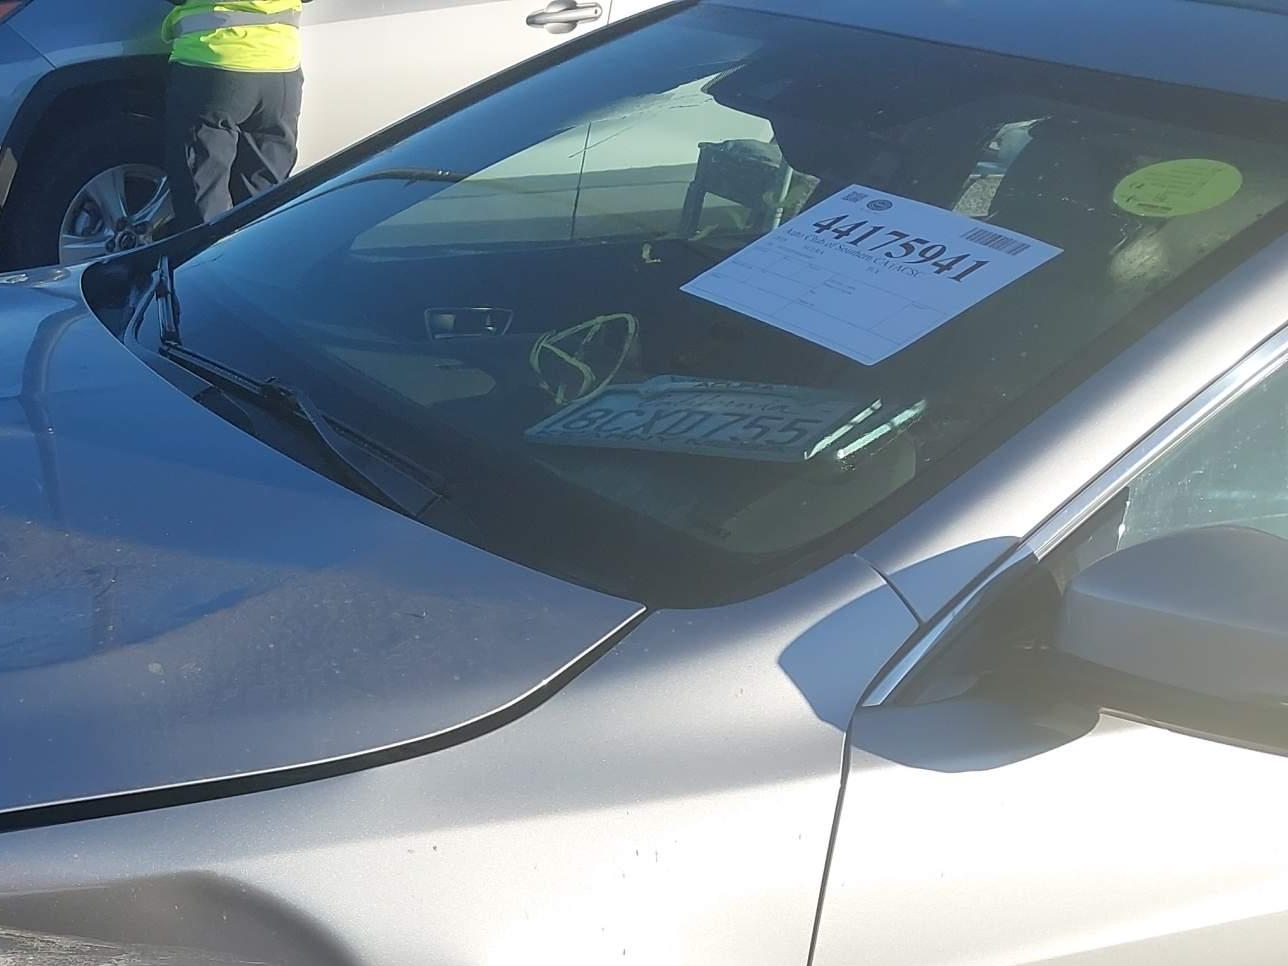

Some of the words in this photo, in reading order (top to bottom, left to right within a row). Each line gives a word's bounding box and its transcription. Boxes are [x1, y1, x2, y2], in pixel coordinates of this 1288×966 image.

[804, 233, 825, 244] Club
[834, 243, 874, 261] Southern
[812, 214, 990, 282] 44175941
[561, 407, 823, 445] 8CXD755
